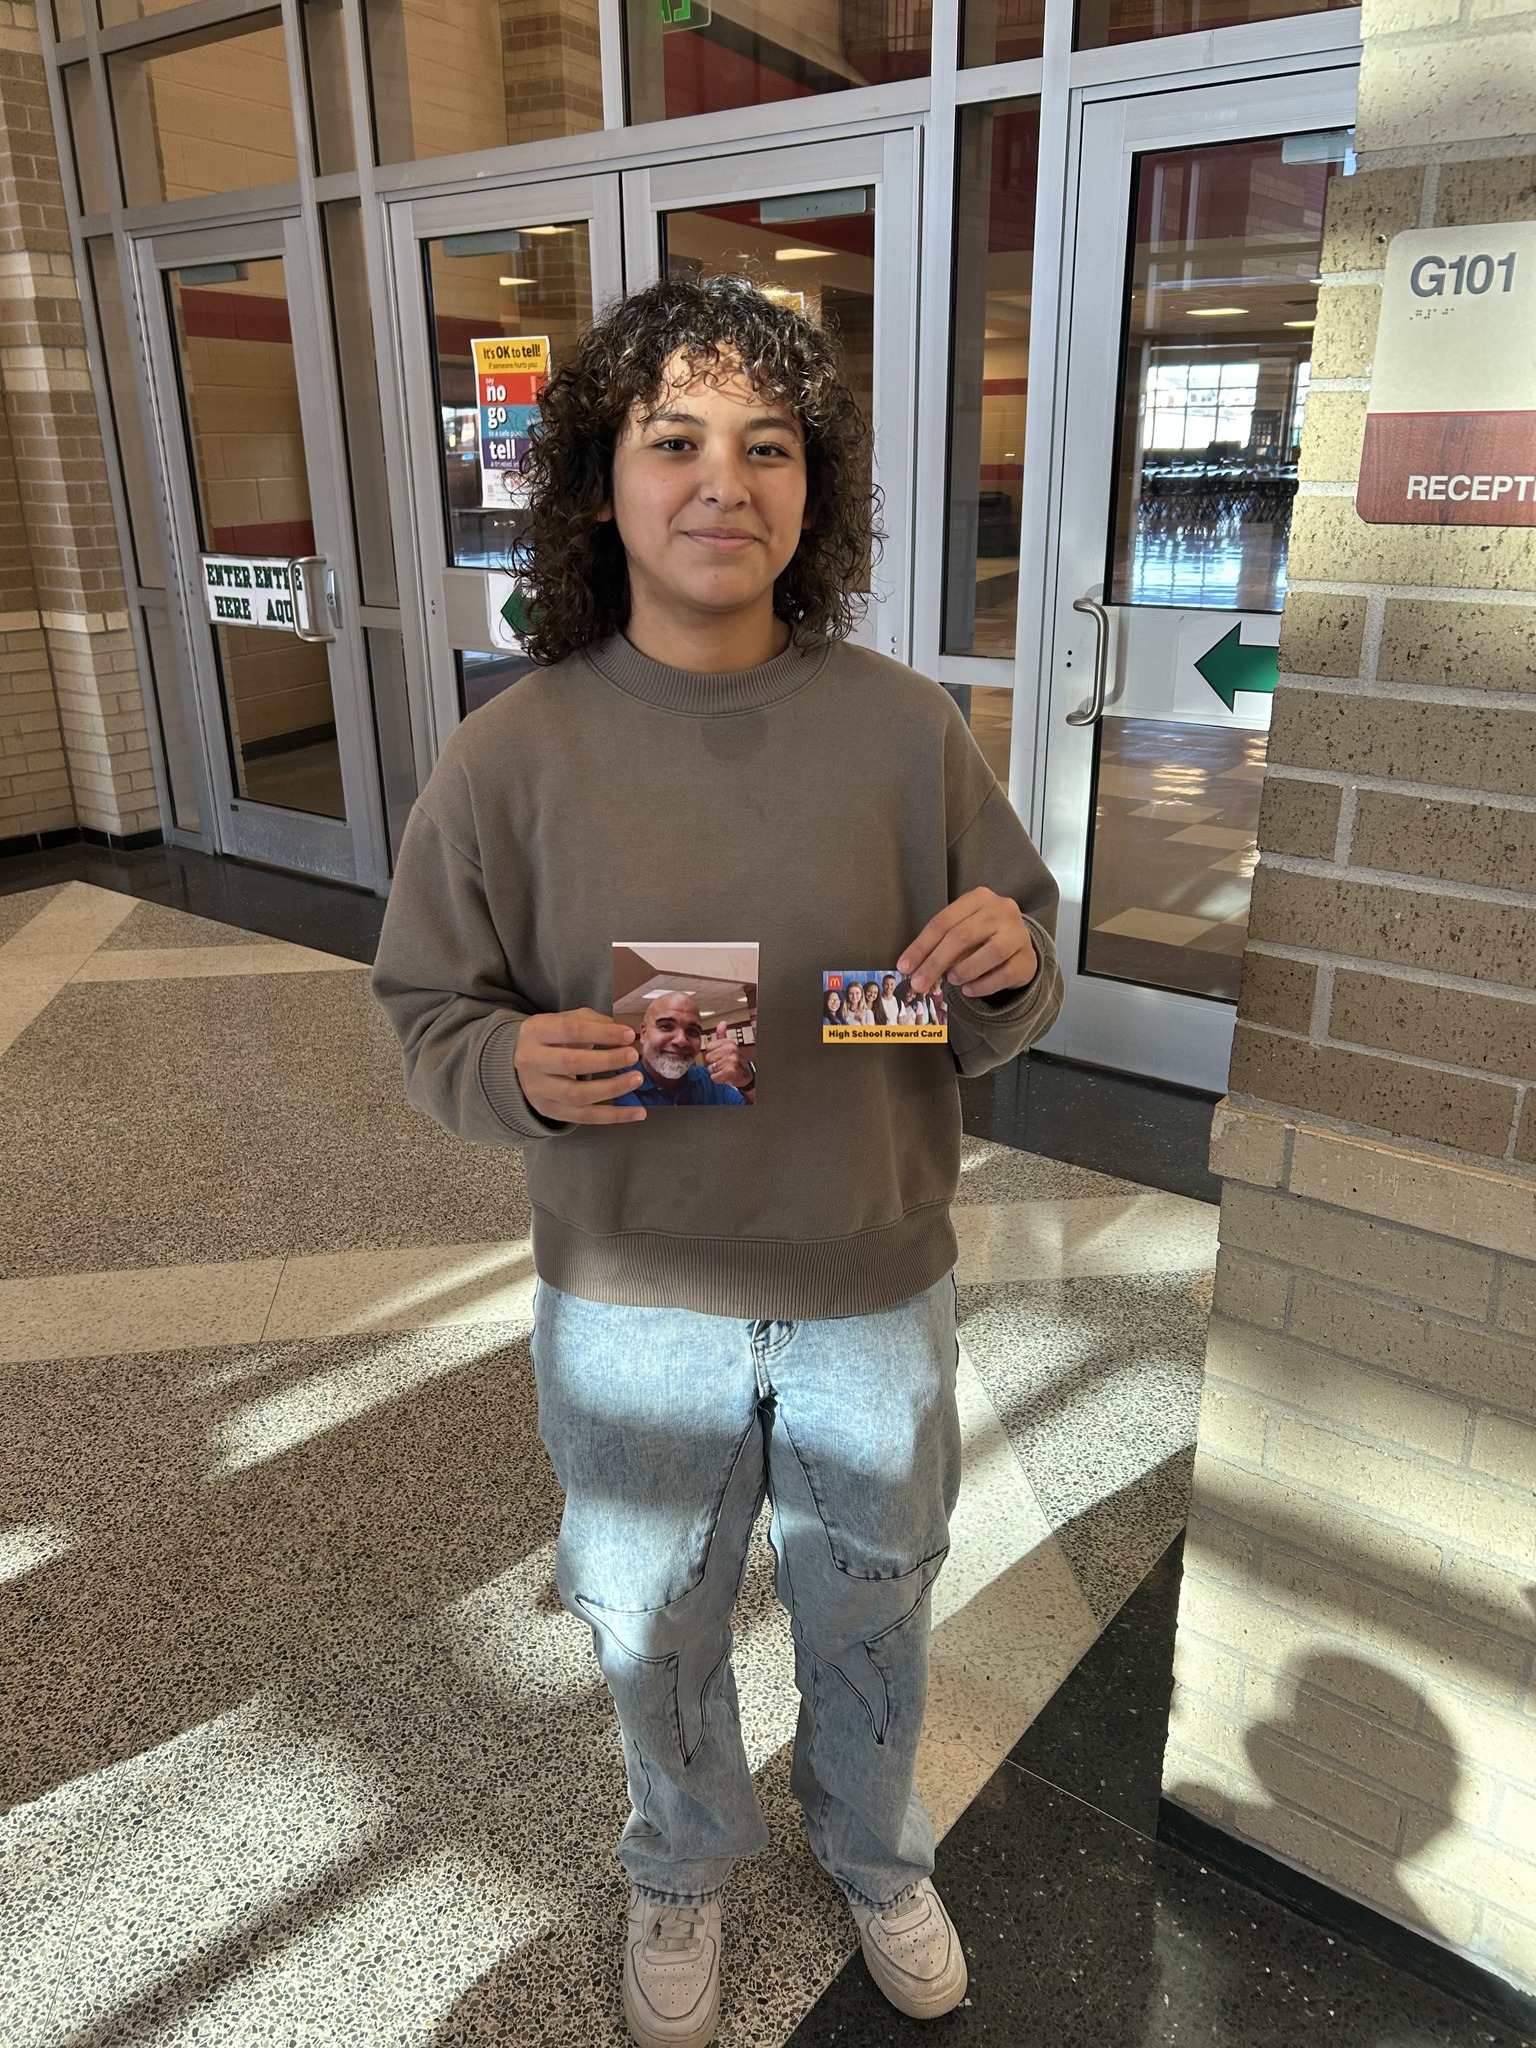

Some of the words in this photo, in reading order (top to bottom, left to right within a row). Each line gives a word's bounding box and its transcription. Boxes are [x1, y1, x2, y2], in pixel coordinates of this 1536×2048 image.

[1410, 252, 1517, 297] G101
[483, 347, 495, 359] It's
[496, 346, 511, 359] OK
[512, 347, 521, 358] to
[522, 344, 541, 357] tell!
[485, 377, 495, 386] say
[486, 384, 507, 402] no
[487, 407, 507, 429] go
[489, 439, 516, 460] tell
[205, 564, 252, 588] ENTER
[215, 596, 252, 620] HERE
[828, 1029, 850, 1040] High
[852, 1029, 883, 1038] School
[885, 1029, 919, 1038] Reward
[920, 1029, 943, 1038] Card
